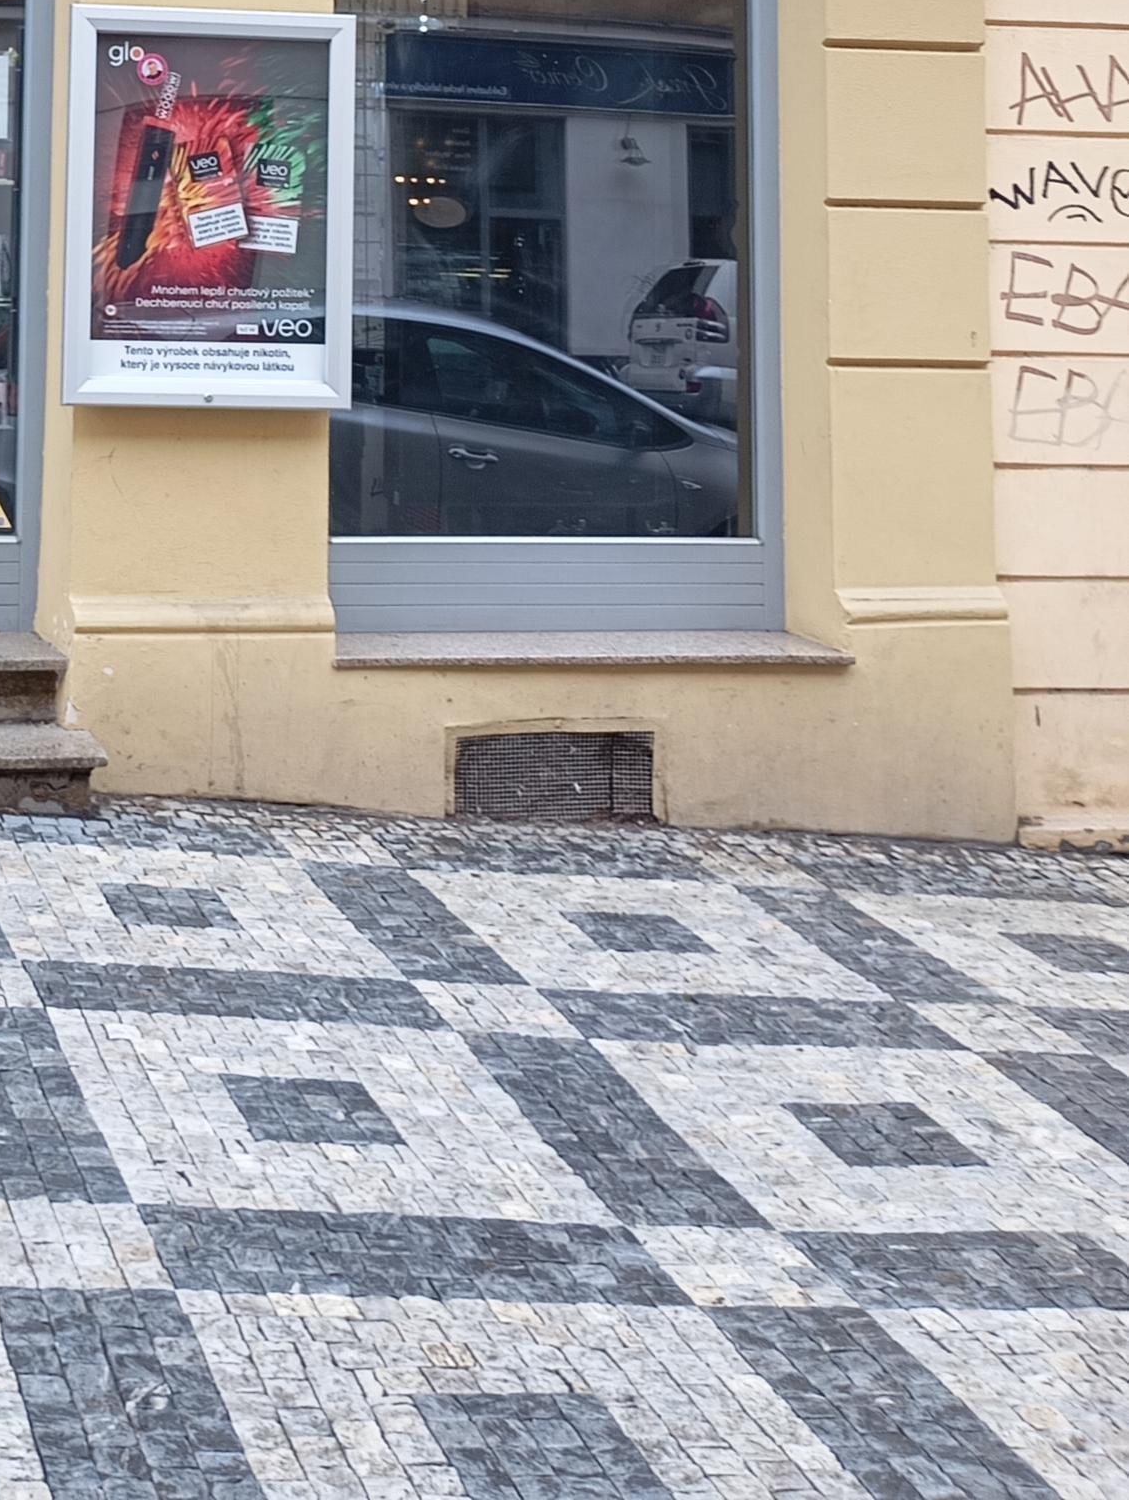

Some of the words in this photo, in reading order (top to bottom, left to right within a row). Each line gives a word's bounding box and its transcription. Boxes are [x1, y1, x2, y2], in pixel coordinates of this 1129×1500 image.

[108, 41, 145, 67] glo
[190, 156, 218, 170] veo
[260, 163, 288, 176] veo
[151, 284, 199, 296] Mnohem
[262, 319, 312, 337] veo
[124, 345, 153, 356] Tento
[156, 346, 198, 358] výrobek
[202, 347, 250, 359] obsahuje
[253, 349, 290, 358] nikotin,
[121, 359, 147, 371] který
[150, 360, 159, 371] je
[163, 361, 200, 372] vysoce
[203, 362, 259, 373] návykovou
[262, 362, 295, 372] látkou
